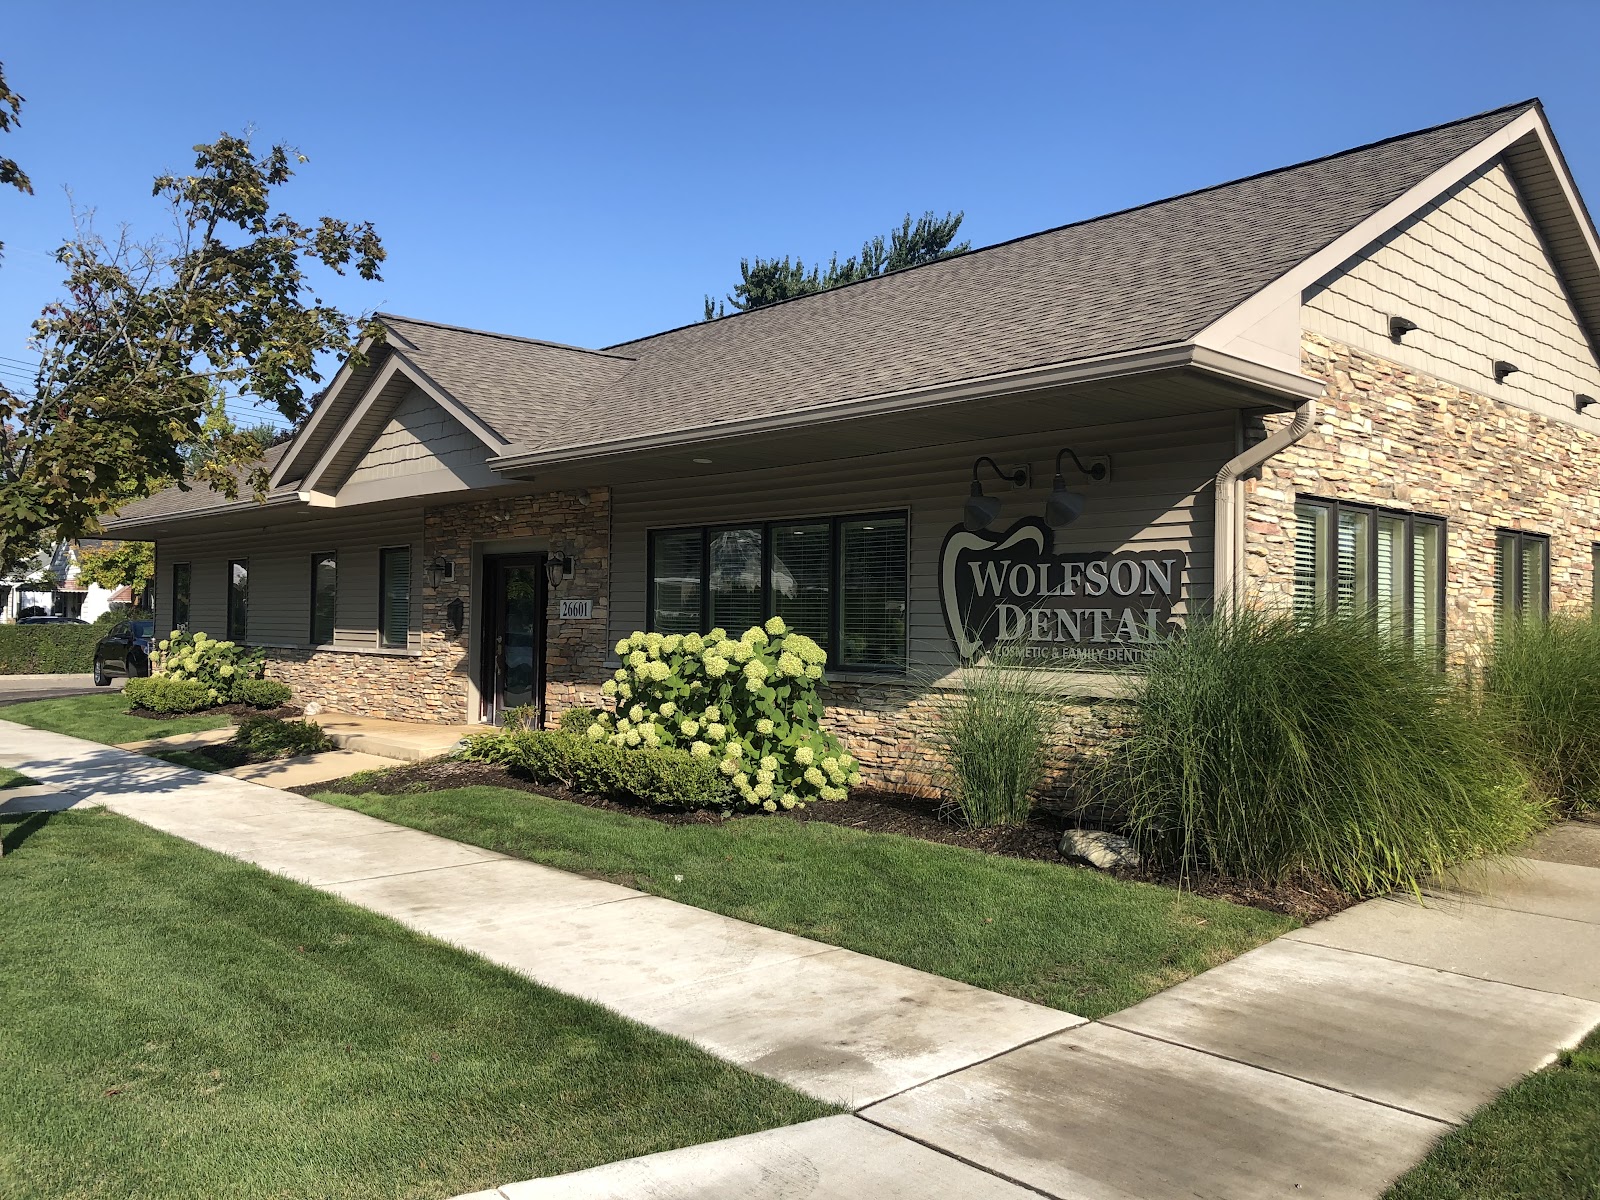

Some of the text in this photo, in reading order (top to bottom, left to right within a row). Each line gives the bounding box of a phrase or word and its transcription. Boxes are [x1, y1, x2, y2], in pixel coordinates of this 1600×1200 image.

[967, 559, 1176, 597] WOLFSON
[562, 601, 588, 617] 26601
[995, 603, 1173, 645] DENTAL
